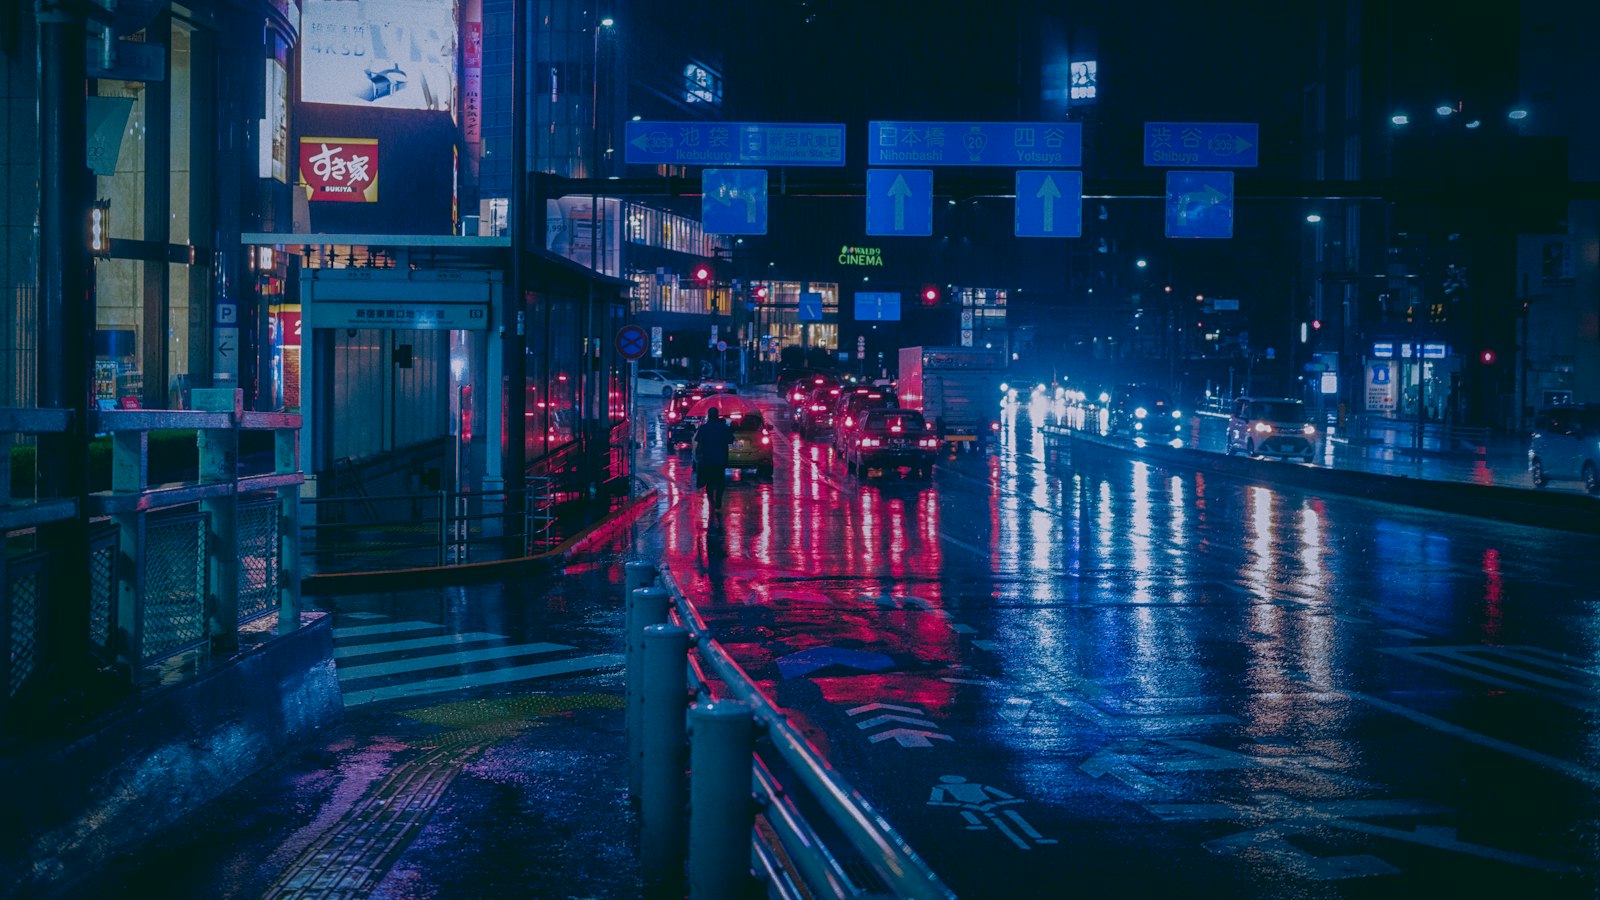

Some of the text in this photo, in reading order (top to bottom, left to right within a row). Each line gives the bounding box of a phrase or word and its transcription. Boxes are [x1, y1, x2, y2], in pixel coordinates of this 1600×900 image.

[651, 137, 667, 148] 305
[679, 127, 729, 147] 池袋
[769, 132, 839, 148] 新宿駅東口
[880, 126, 945, 147] 日本橋
[968, 136, 982, 149] 20
[1014, 127, 1065, 148] 四谷
[1151, 127, 1202, 148] 渋谷
[1214, 139, 1232, 150] 305
[676, 149, 731, 162] Ikebukuro
[769, 148, 806, 159] Shinjuku
[880, 149, 943, 161] Nihonbashi
[1017, 150, 1061, 164] Yotsuya
[1153, 150, 1199, 164] Shibuya
[309, 144, 369, 186] すき家
[838, 254, 883, 266] CINEMA
[222, 307, 232, 320] P
